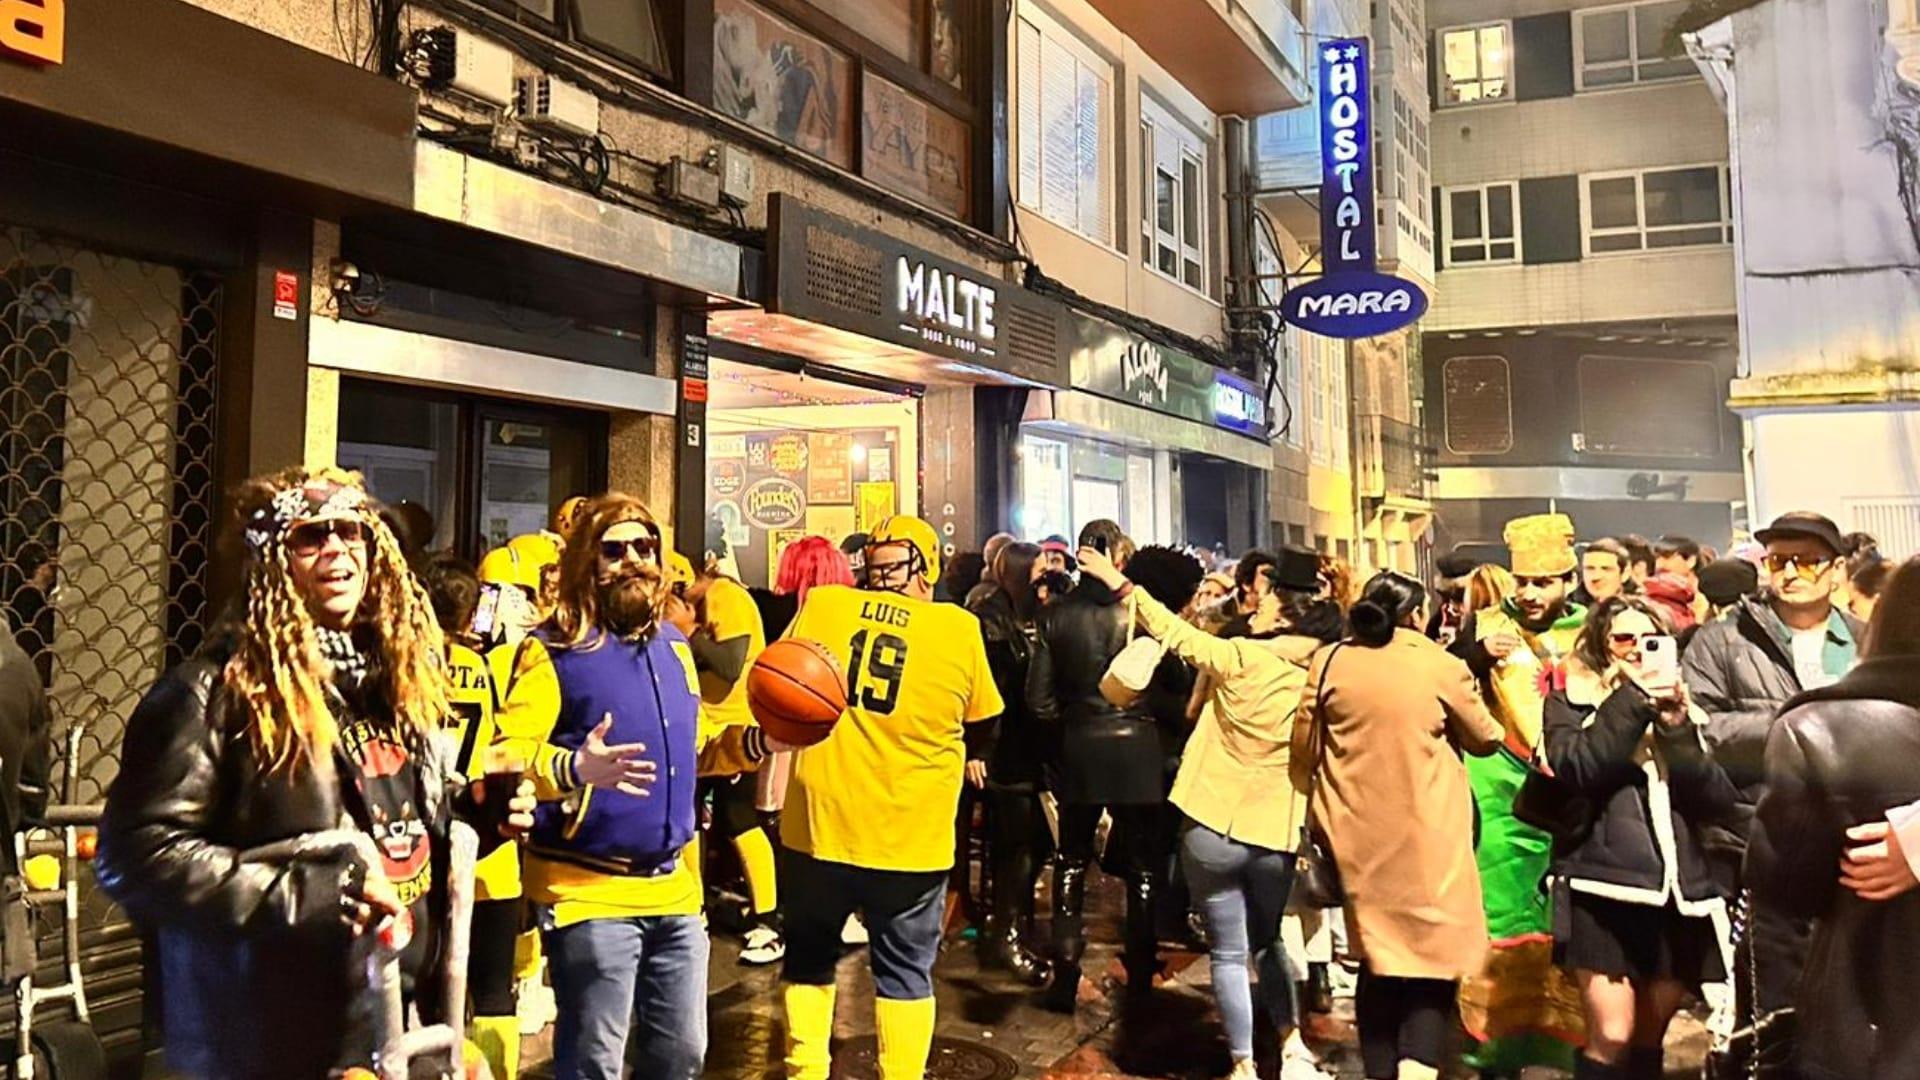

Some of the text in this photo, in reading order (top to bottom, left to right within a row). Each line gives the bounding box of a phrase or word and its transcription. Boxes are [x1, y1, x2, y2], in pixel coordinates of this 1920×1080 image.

[1329, 62, 1361, 262] HOSTAL
[898, 255, 996, 340] MALTE
[1297, 289, 1412, 319] MARA
[1121, 342, 1168, 403] ALOHA
[859, 600, 911, 628] LUIS
[846, 628, 908, 716] 19
